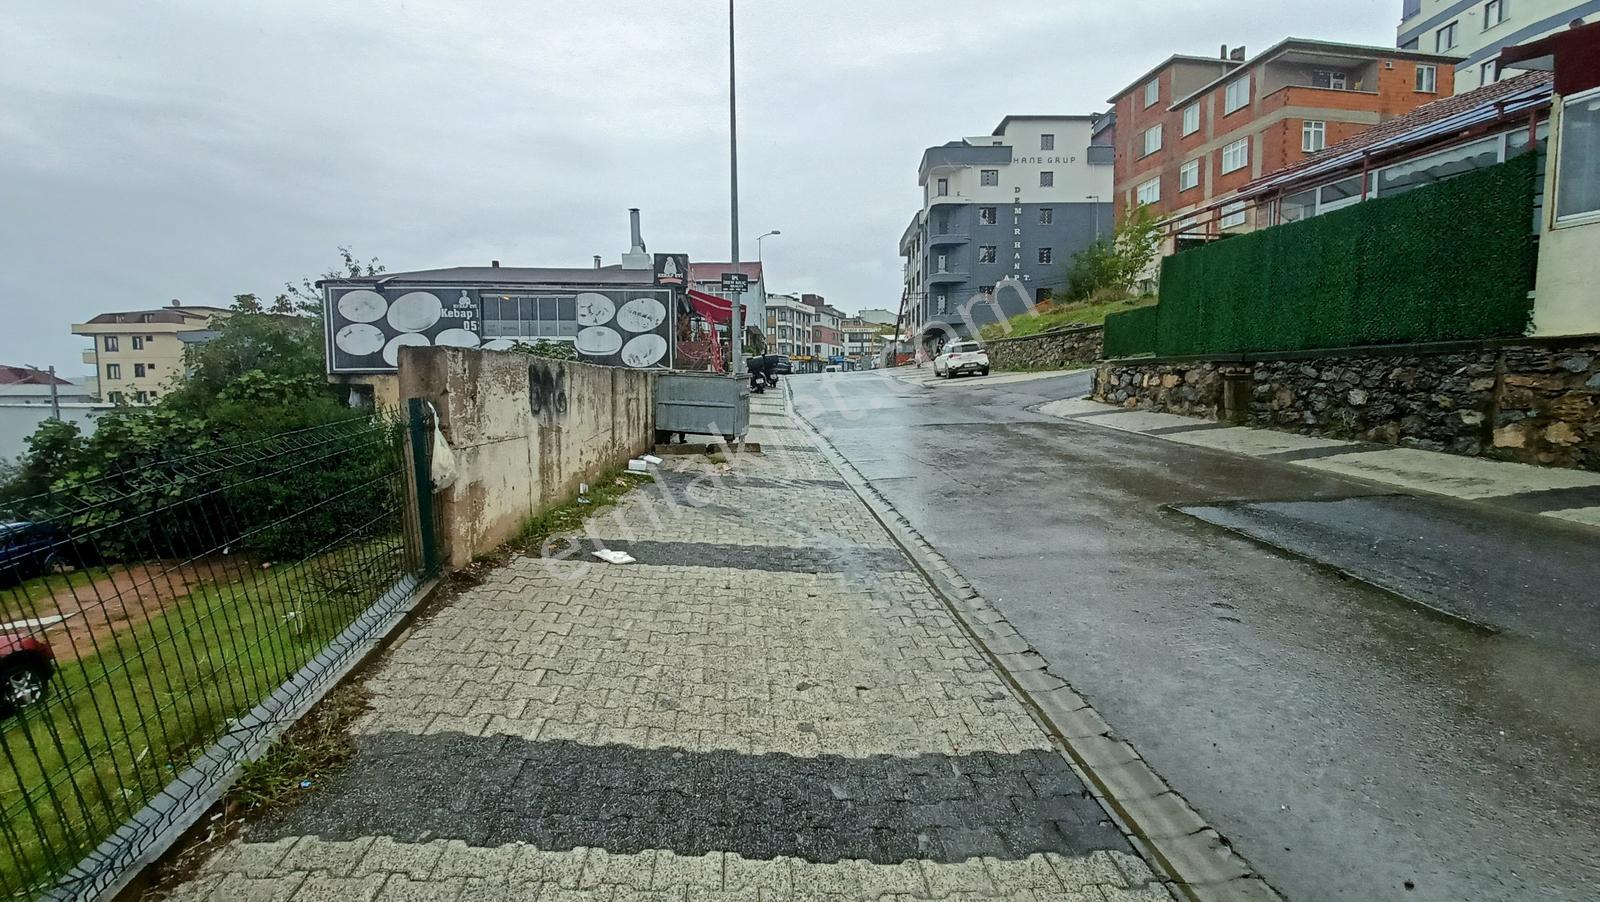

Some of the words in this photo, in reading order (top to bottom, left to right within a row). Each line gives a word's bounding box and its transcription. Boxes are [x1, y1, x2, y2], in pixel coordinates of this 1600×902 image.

[1013, 156, 1042, 164] HANE
[1047, 156, 1076, 164] GRUP
[441, 308, 473, 320] Kebap
